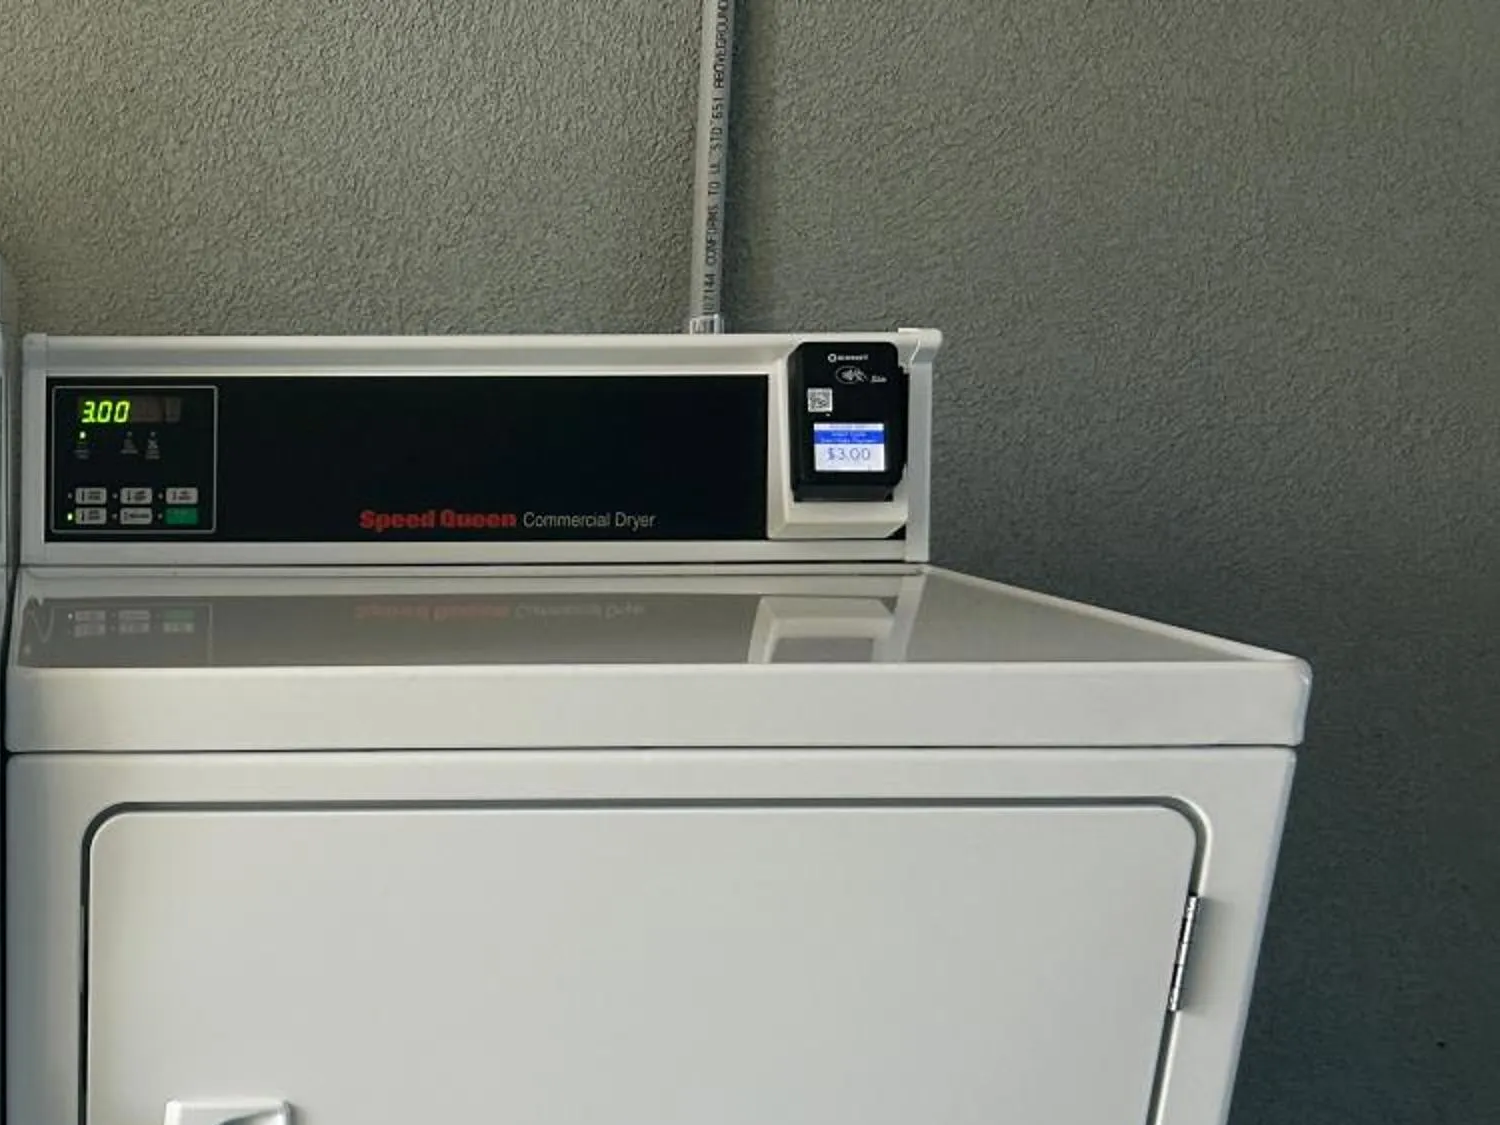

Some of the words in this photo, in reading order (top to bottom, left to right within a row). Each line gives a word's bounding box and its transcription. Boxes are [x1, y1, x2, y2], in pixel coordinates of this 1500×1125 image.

[711, 97, 724, 120] 651
[709, 127, 723, 150] STD
[708, 181, 720, 195] TO
[705, 204, 719, 266] CONFORMS
[827, 447, 871, 461] $3.00
[359, 510, 436, 533] Speed
[440, 509, 517, 529] Queen
[523, 511, 611, 528] Commercial
[615, 511, 656, 532] Dryer
